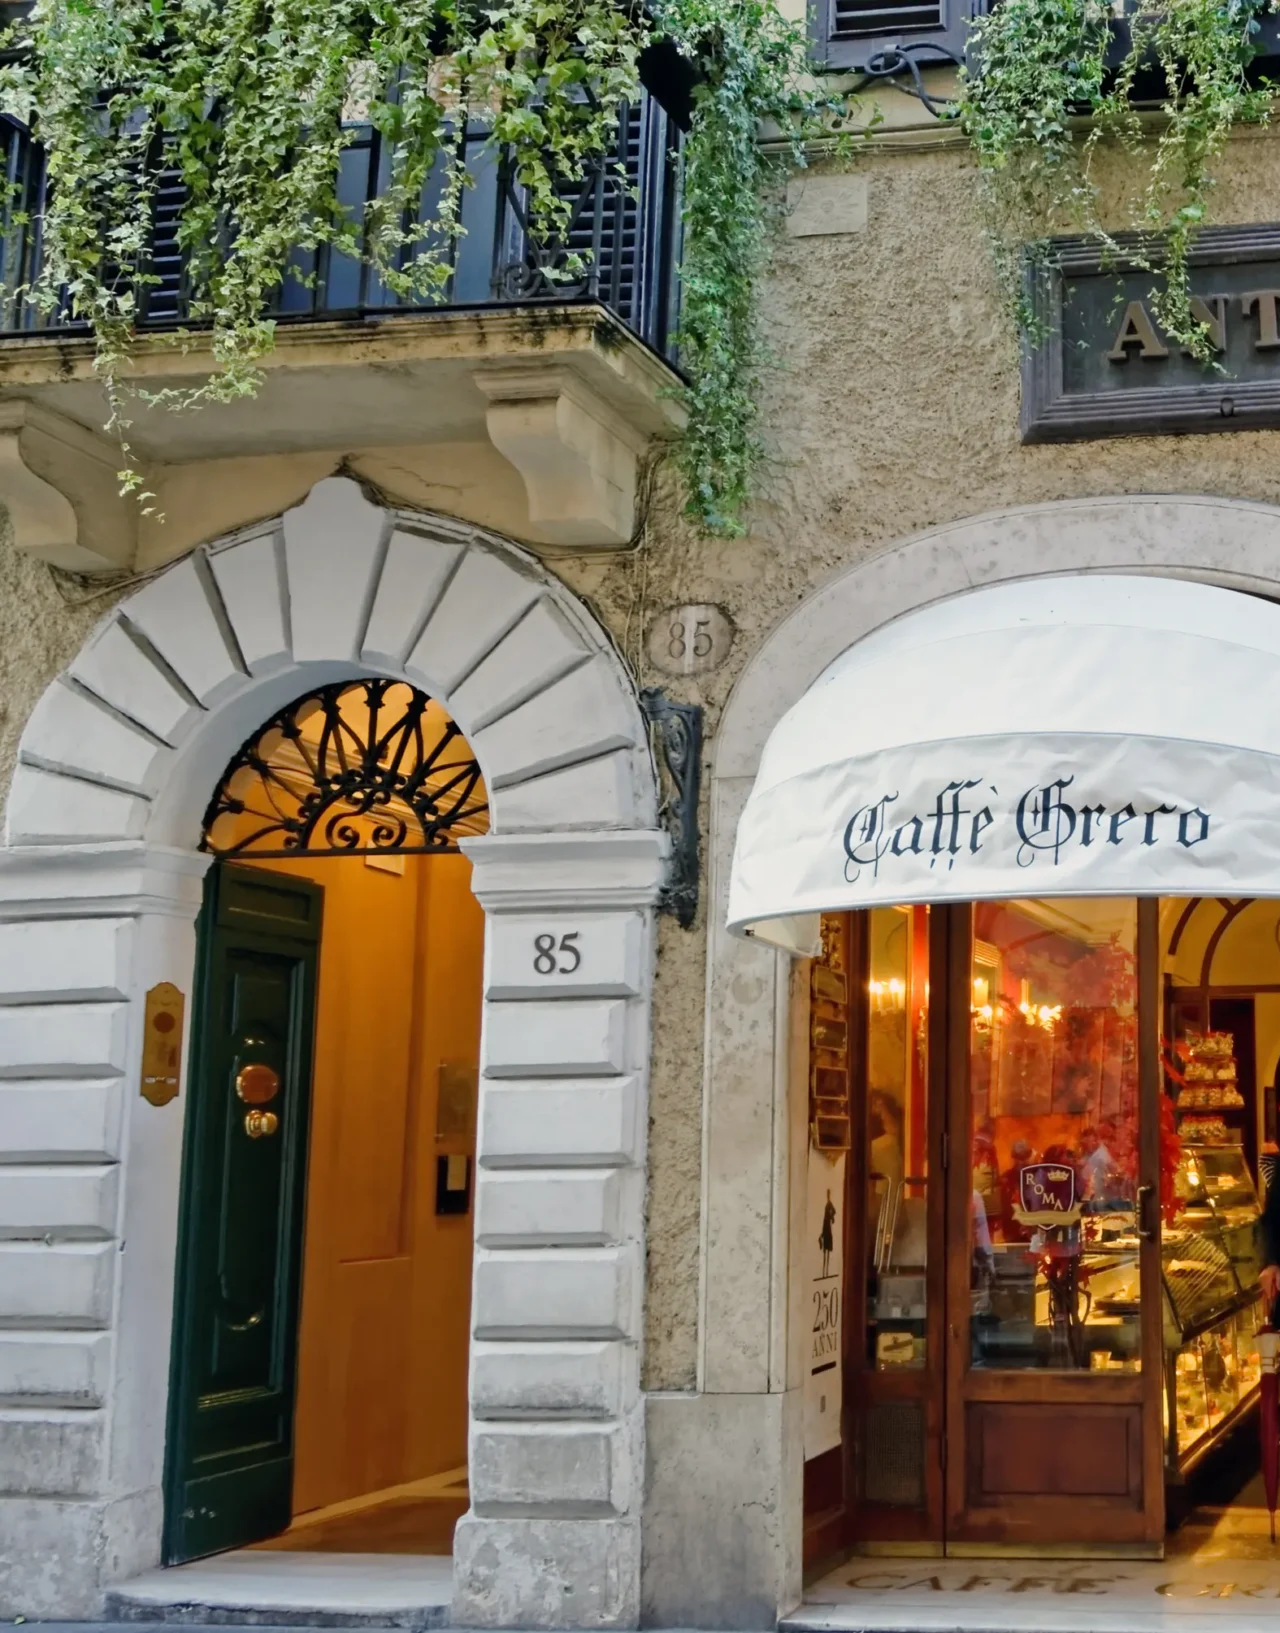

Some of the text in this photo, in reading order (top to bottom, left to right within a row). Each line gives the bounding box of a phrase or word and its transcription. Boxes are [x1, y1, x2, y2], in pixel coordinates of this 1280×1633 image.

[668, 620, 713, 659] 85
[843, 777, 999, 881] Caffè
[533, 930, 581, 975] 85
[1025, 1173, 1064, 1211] ROMA
[812, 1287, 839, 1333] 250
[812, 1331, 838, 1359] ANNI
